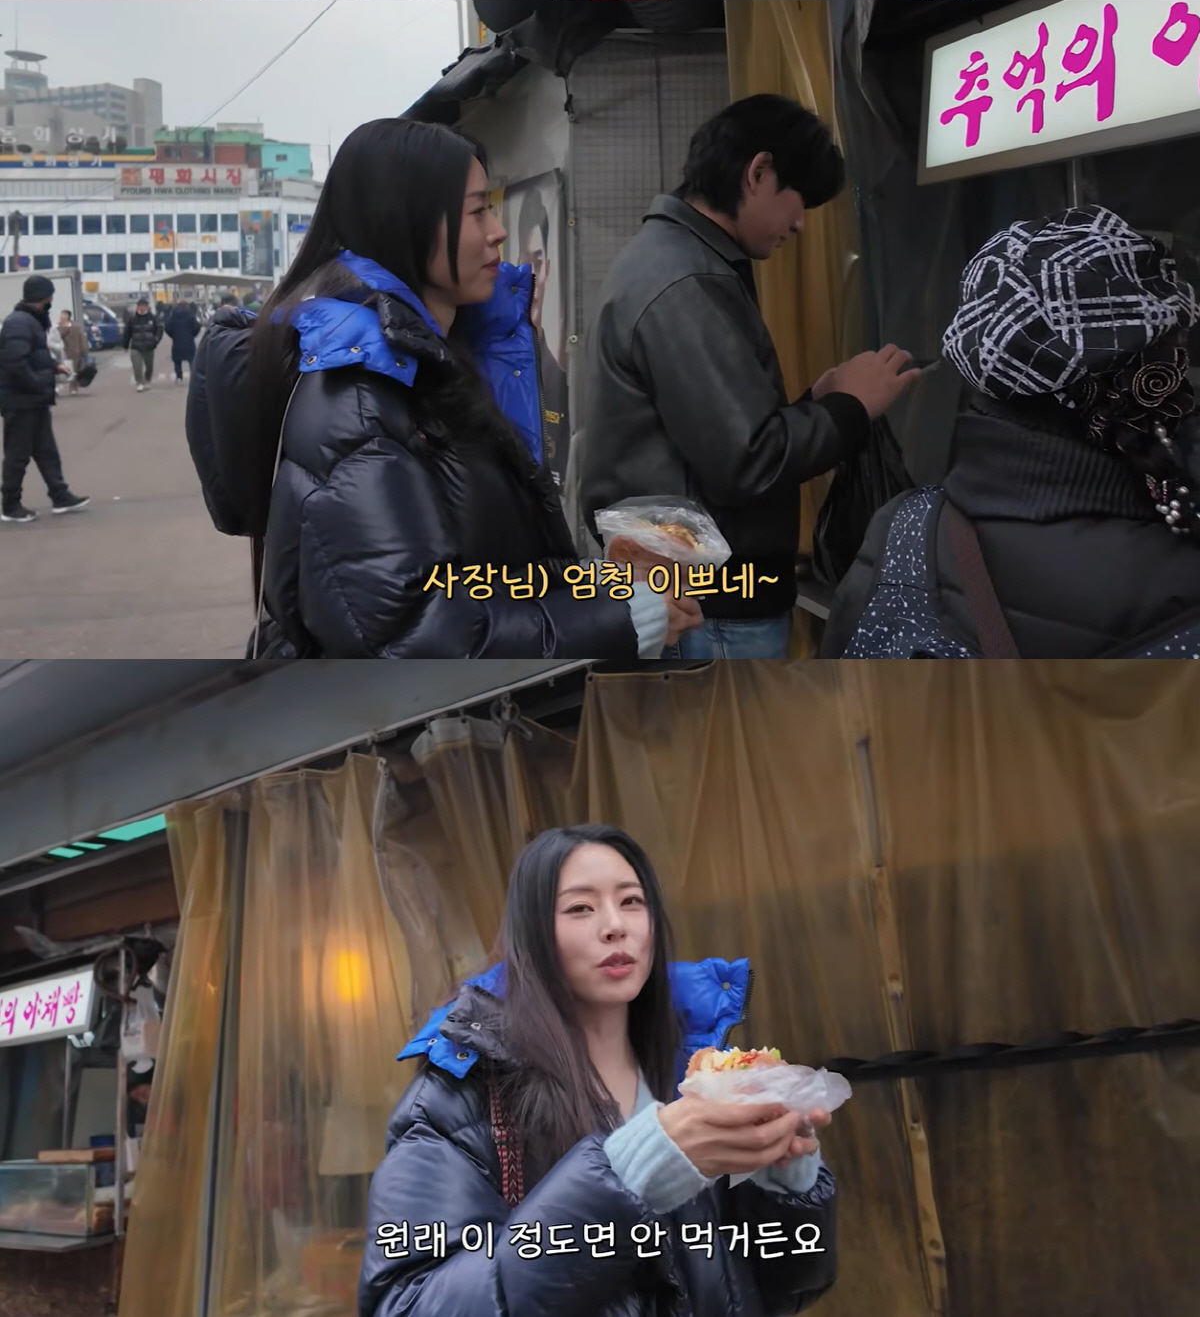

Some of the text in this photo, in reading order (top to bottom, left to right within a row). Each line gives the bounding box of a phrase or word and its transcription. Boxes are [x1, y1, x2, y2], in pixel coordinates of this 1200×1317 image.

[939, 3, 1118, 148] 추억의
[149, 167, 242, 186] 평화시장
[154, 187, 173, 195] HWA
[175, 187, 211, 195] CLOTHING
[0, 981, 83, 1035] 의 야채빵
